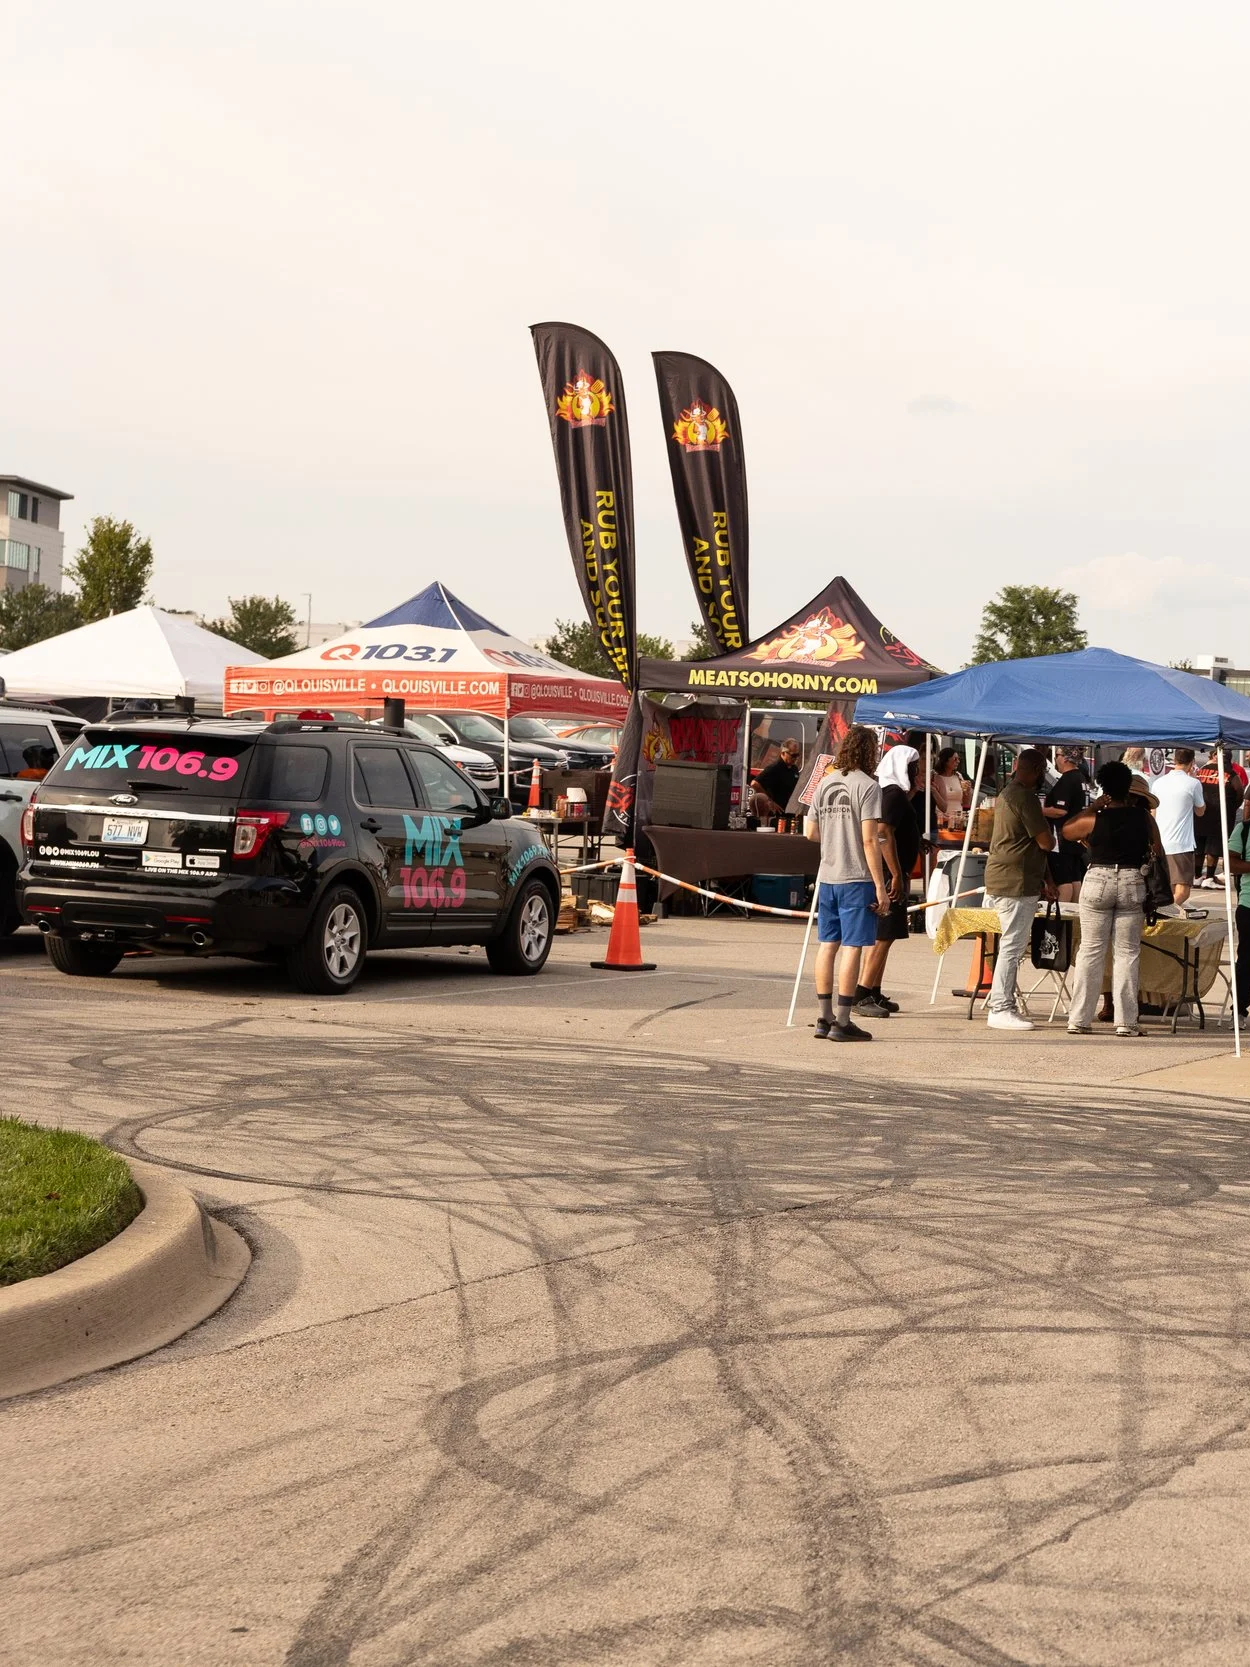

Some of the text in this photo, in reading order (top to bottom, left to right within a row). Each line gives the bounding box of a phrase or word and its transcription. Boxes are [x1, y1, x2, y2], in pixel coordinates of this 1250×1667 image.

[595, 490, 617, 550] RUB
[580, 519, 598, 582] AND
[693, 536, 713, 594] AND
[603, 558, 626, 638] YOUR
[712, 511, 743, 649] RUB YOUR
[320, 643, 458, 664] Q103.1
[272, 678, 499, 695] @QLOUISVILLE QLOUISVILLE.COM
[531, 684, 573, 700] @QLOUISVILLE
[688, 669, 878, 694] MEATSOHORNY.COM
[64, 744, 239, 782] MIX 106.9
[107, 824, 123, 836] 577
[402, 814, 464, 867] MIX
[400, 867, 467, 909] 106.9
